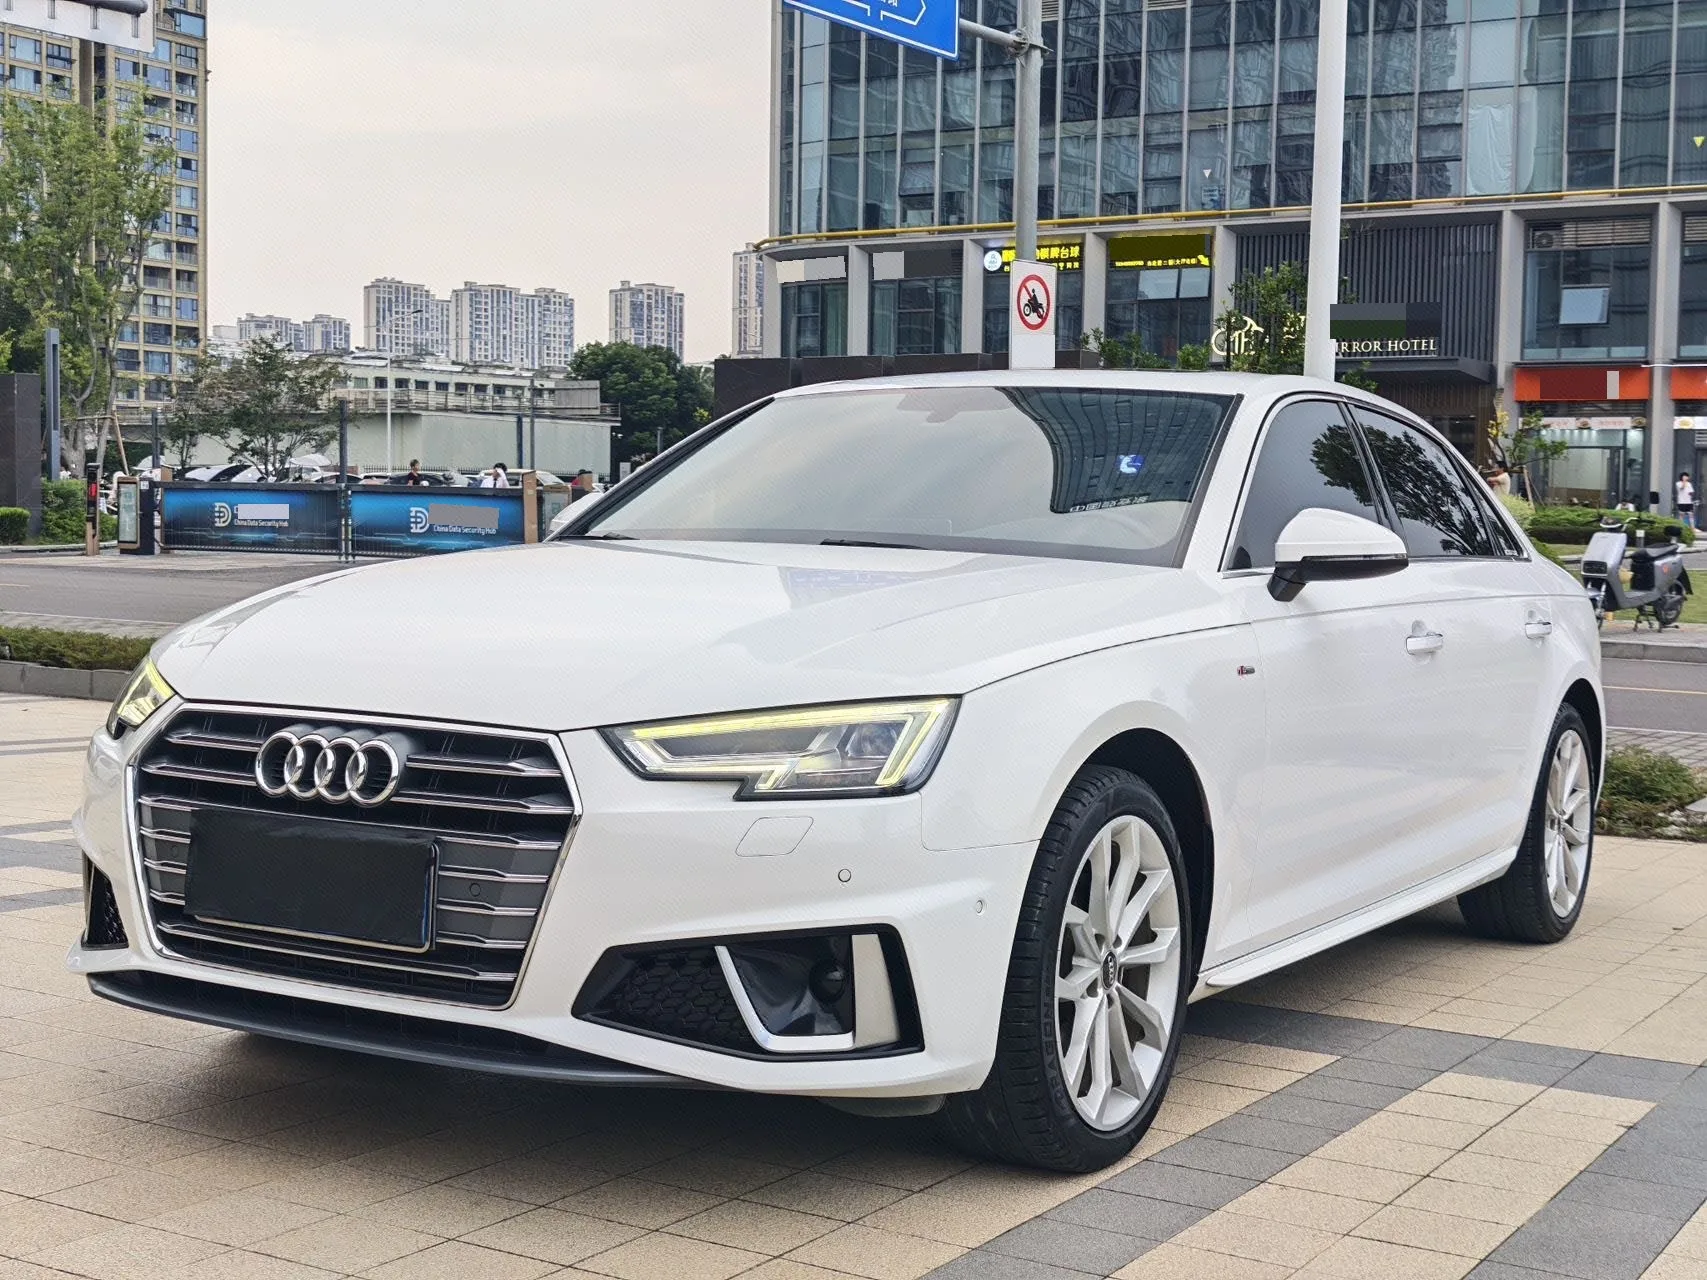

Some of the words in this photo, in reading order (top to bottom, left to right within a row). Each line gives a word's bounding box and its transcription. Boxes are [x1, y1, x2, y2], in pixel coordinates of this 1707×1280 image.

[1388, 339, 1437, 352] HOTEL
[259, 520, 279, 528] Security
[462, 527, 485, 535] Security
